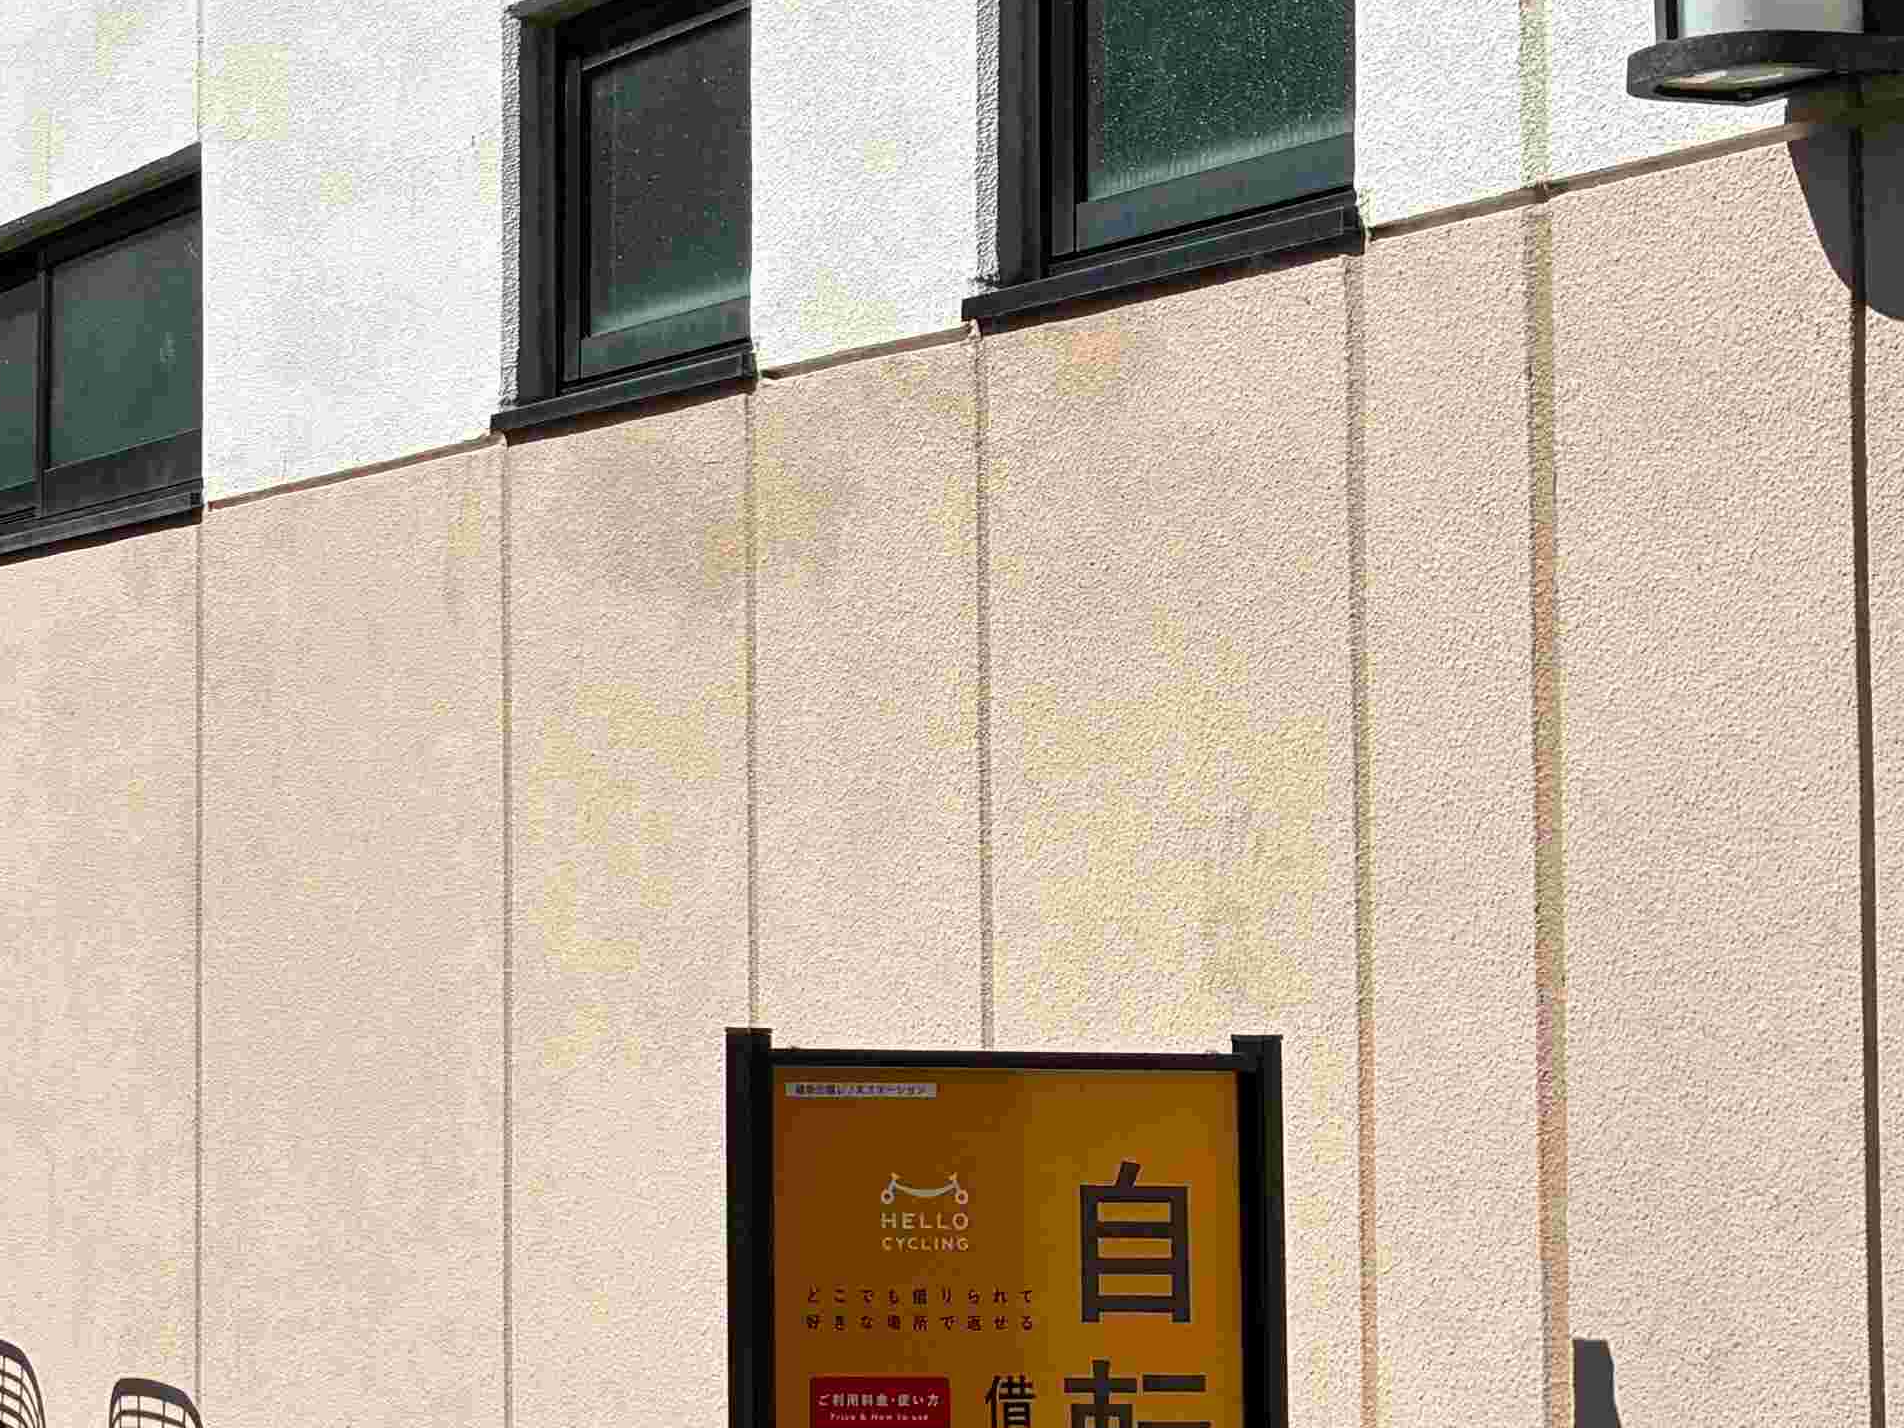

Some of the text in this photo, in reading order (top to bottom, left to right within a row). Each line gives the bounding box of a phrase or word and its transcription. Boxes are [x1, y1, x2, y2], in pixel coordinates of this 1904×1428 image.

[880, 1212, 969, 1230] HELLO
[880, 1236, 969, 1251] CYCLING
[806, 1286, 1034, 1306] どこでも借りられて
[806, 1314, 1034, 1332] 好きな場所で返せる
